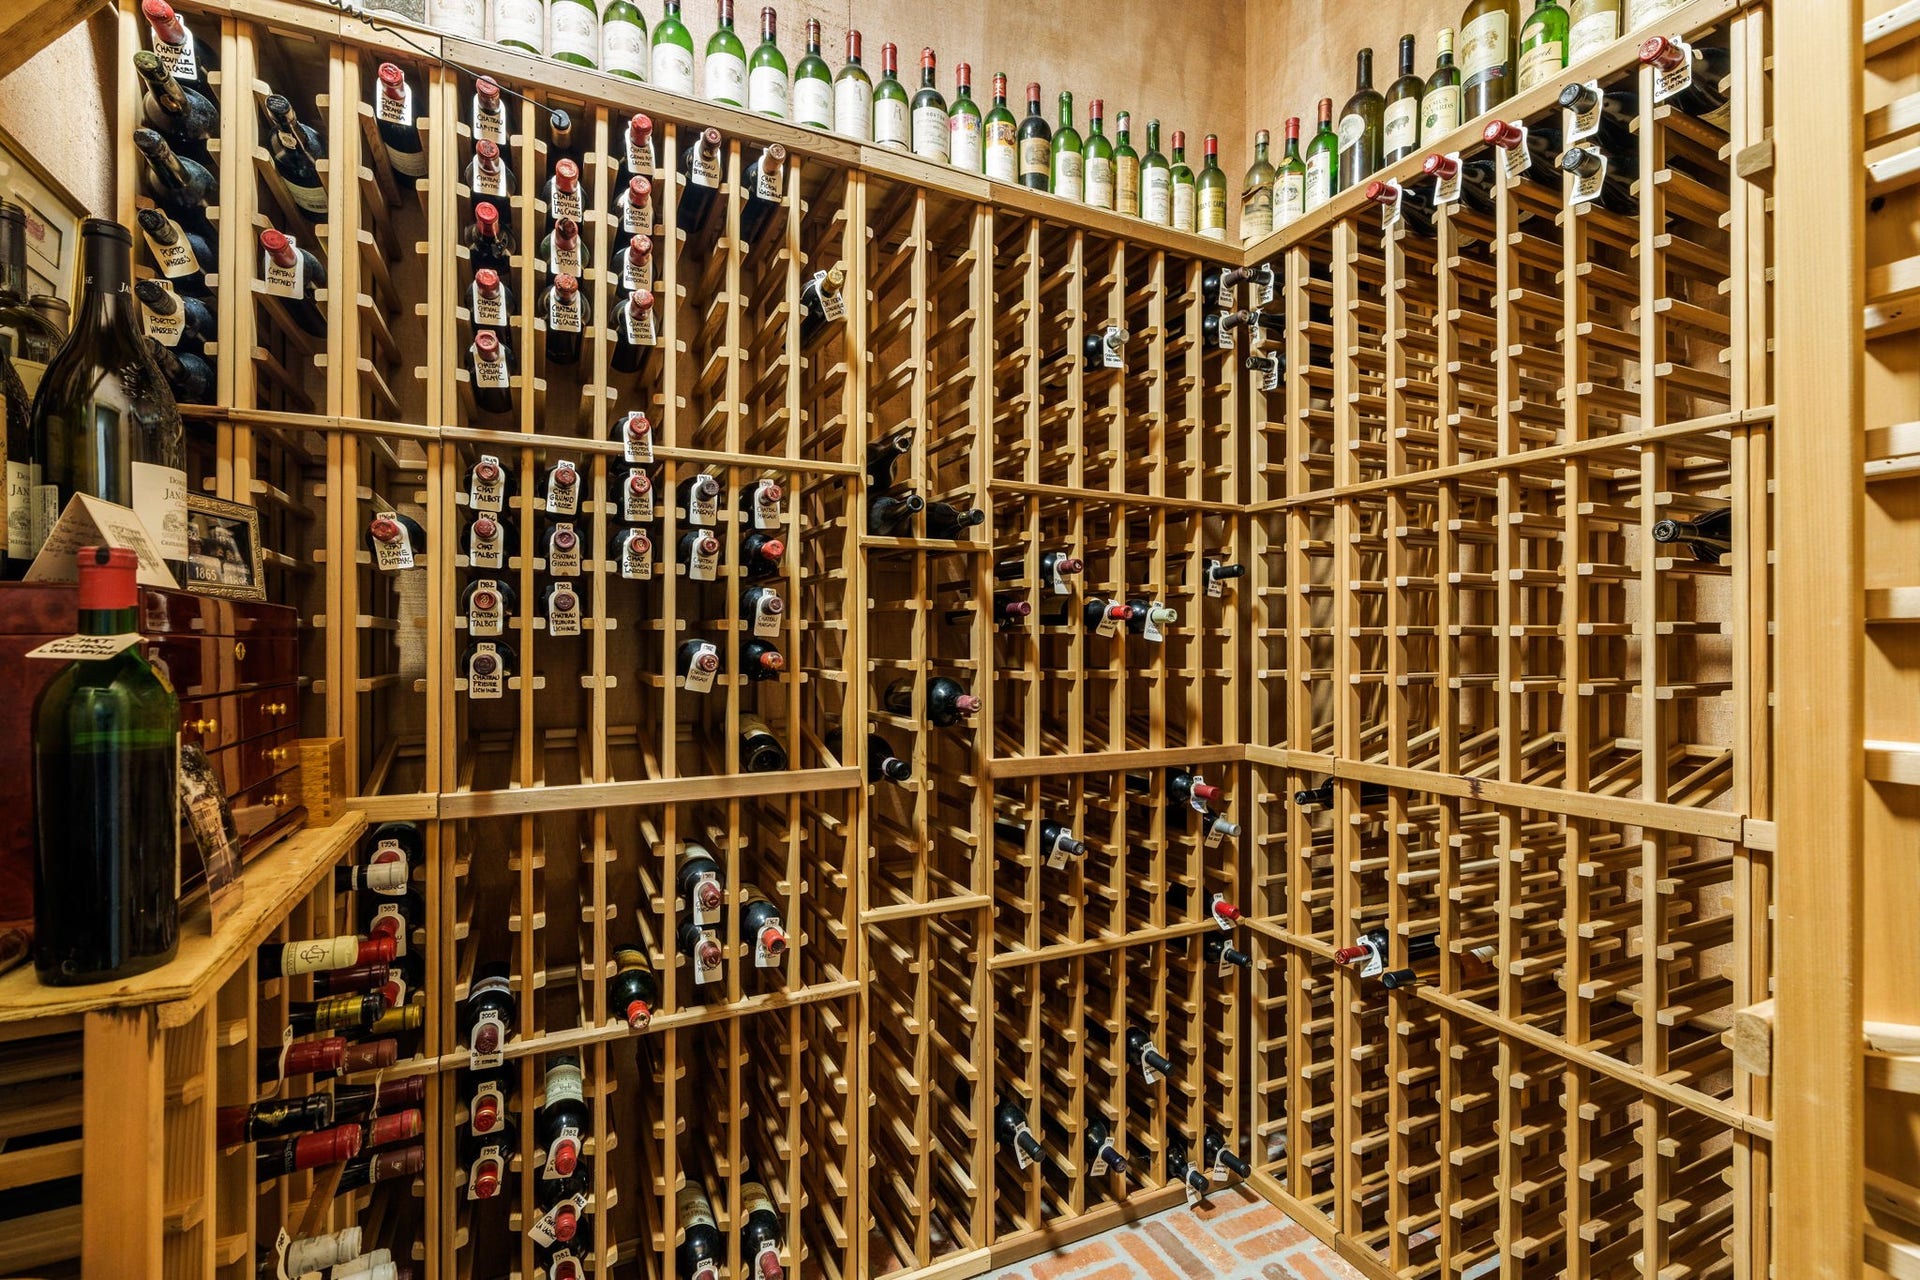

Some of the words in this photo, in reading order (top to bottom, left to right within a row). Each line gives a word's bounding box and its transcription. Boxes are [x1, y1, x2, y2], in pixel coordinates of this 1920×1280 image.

[156, 43, 191, 57] CHATEAU
[158, 53, 194, 66] EOVILLE
[477, 114, 503, 125] CHATEAU
[553, 192, 580, 203] CHATEAU
[160, 246, 184, 259] PORTO
[556, 250, 575, 259] CHAT
[555, 257, 581, 267] LATOUR
[268, 266, 295, 278] CHATEAU
[477, 298, 502, 308] CHATEAU
[551, 305, 578, 314] CHATEAU
[150, 316, 176, 325] PORTO
[552, 312, 579, 321] LEOVILLE
[477, 362, 503, 371] CHATEAU
[476, 485, 495, 494] CHAT
[552, 487, 572, 496] CHAT
[473, 493, 501, 503] TALBOT
[384, 542, 405, 550] CHAT
[476, 543, 494, 552] CHAT
[381, 549, 409, 559] BRANE
[472, 551, 500, 560] TALBOT
[552, 552, 577, 560] CHATEAU
[626, 555, 645, 563] CHAT
[194, 567, 218, 582] 1865
[480, 581, 495, 589] 1982
[471, 611, 499, 619] CHATEAU
[551, 612, 576, 620] CHATEAU
[471, 619, 498, 628] TALBOT
[65, 637, 116, 645] CHAT
[480, 644, 494, 652] 1982
[472, 674, 500, 682] CHATEAU
[481, 1011, 496, 1021] 2005
[562, 1128, 576, 1137] 1982
[554, 1251, 570, 1261] 1982
